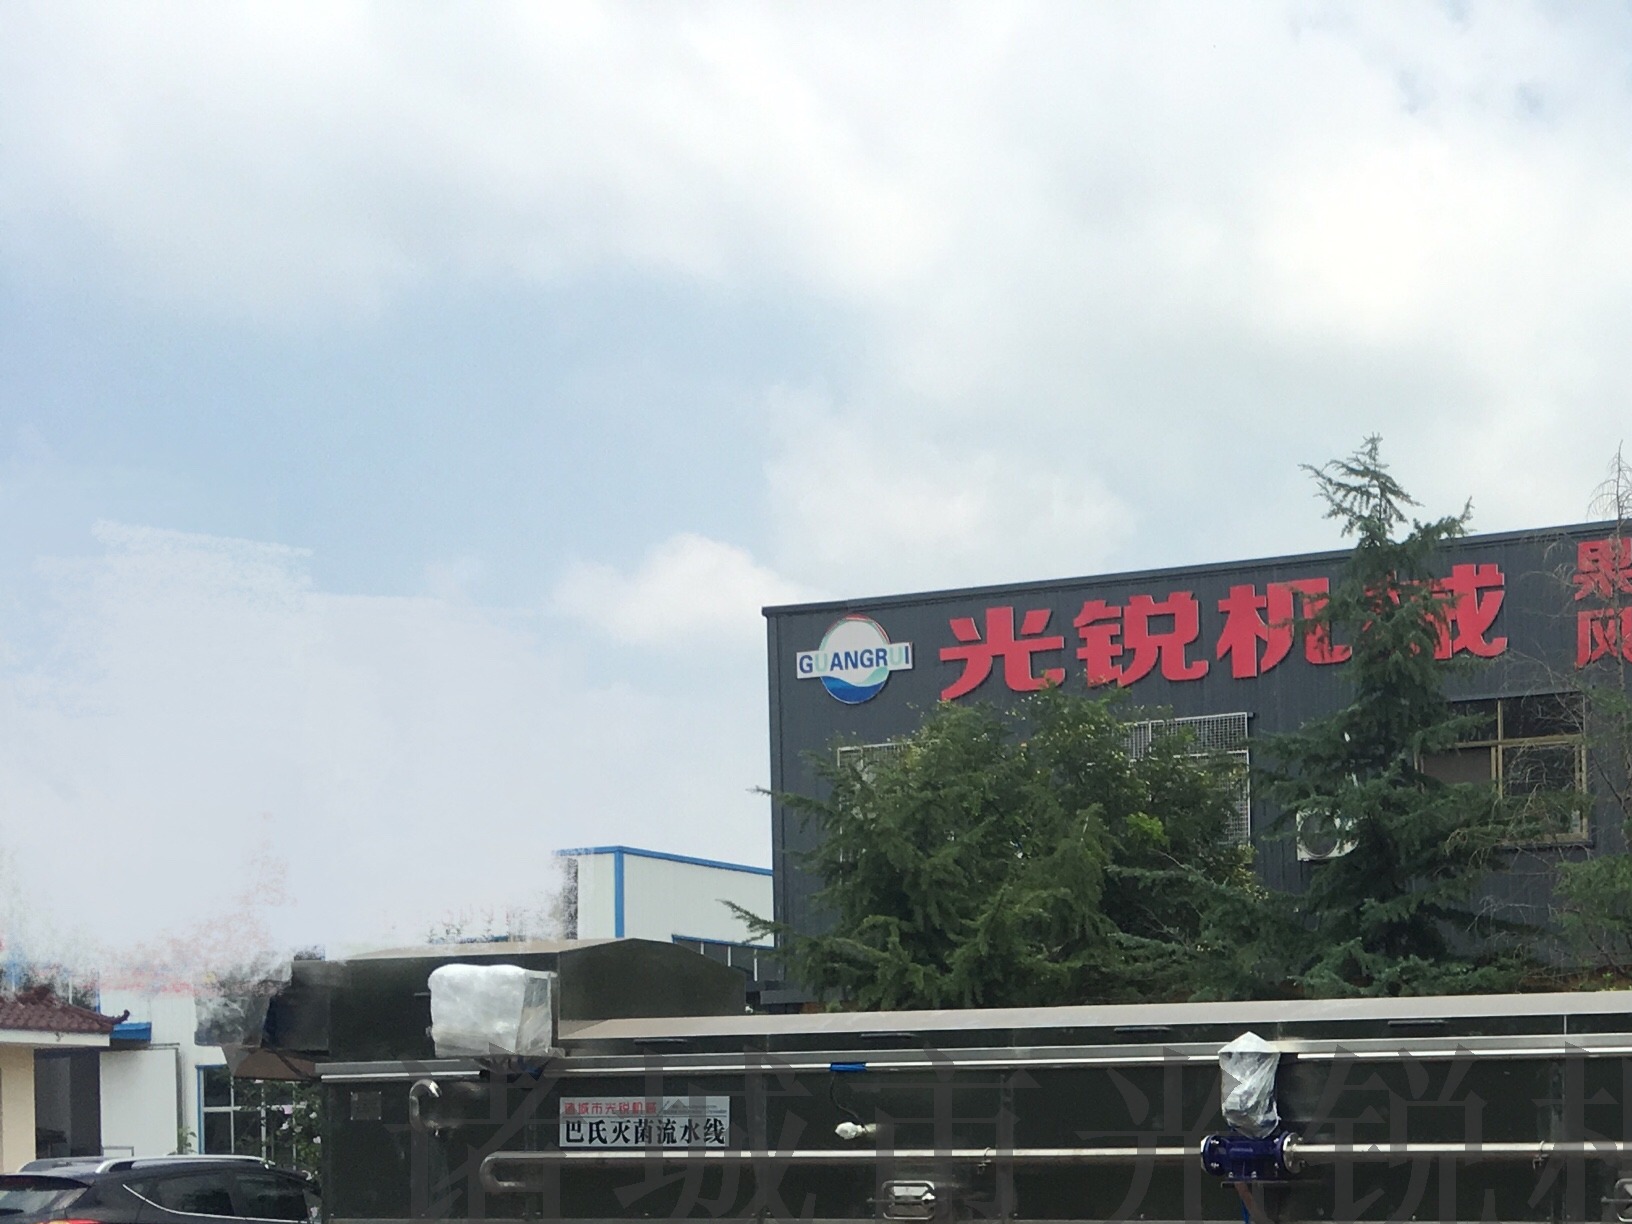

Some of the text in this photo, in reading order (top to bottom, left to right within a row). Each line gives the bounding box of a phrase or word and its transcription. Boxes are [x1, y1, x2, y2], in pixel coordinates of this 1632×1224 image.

[938, 563, 1509, 701] 光锐机械
[799, 645, 911, 674] GUANGRUI
[565, 1118, 725, 1145] 巴氏灭菌流水线
